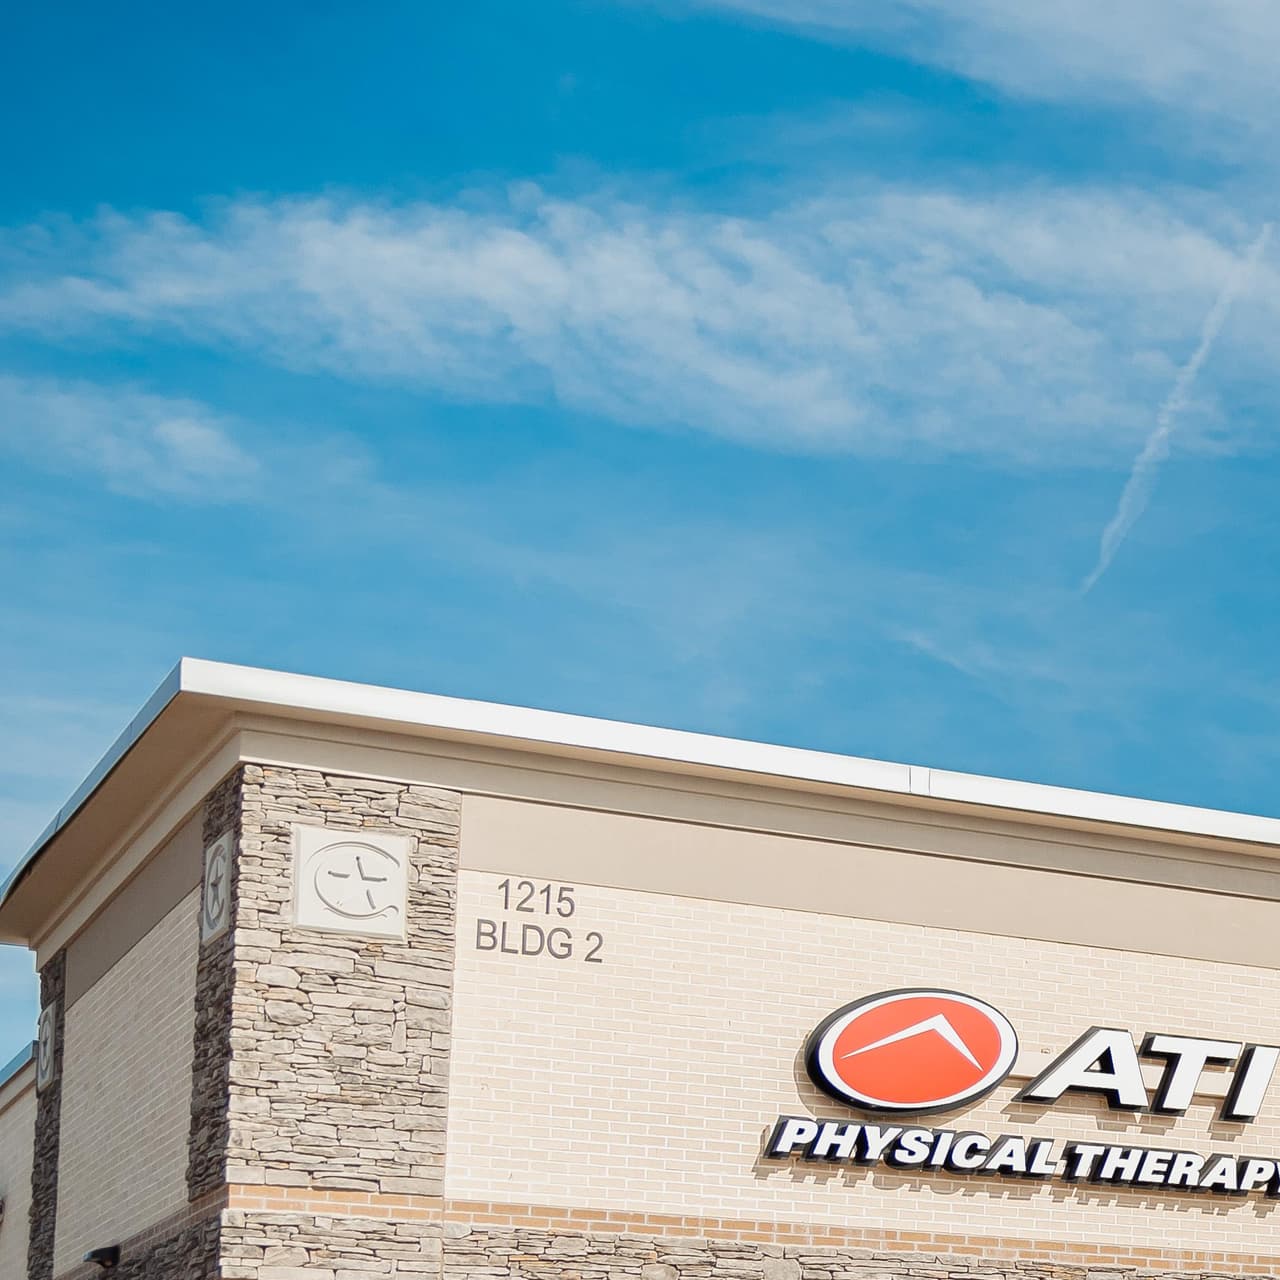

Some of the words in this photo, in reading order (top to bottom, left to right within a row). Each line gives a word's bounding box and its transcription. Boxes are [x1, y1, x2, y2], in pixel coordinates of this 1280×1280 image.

[498, 878, 575, 918] 1215
[476, 918, 573, 960] BLDG
[584, 931, 604, 964] 2
[1016, 1026, 1280, 1120] ATI
[772, 1117, 1056, 1176] PHYSICAL
